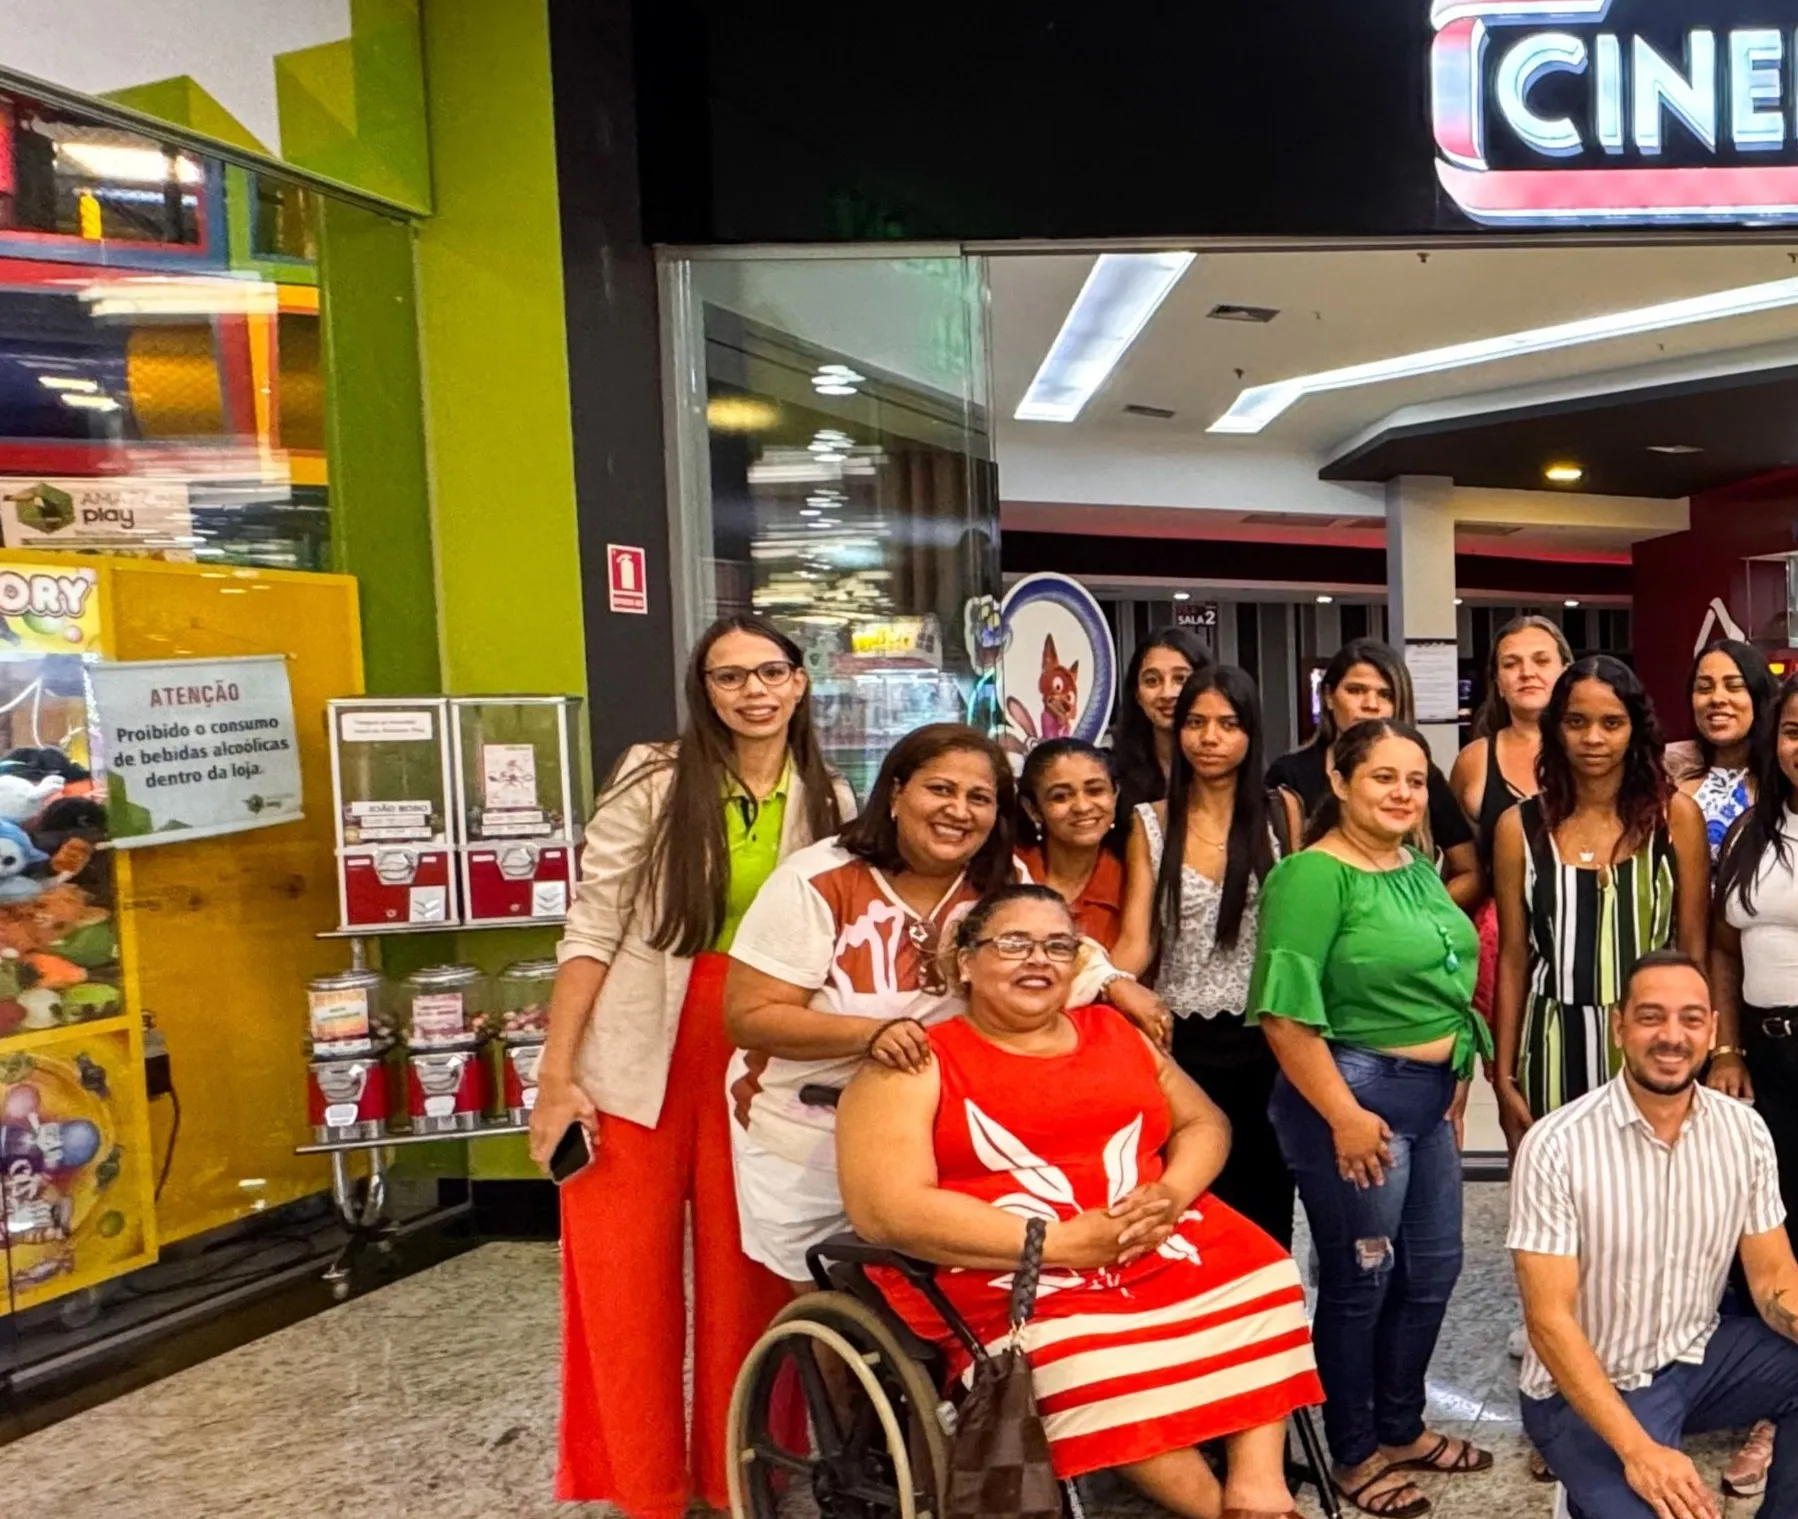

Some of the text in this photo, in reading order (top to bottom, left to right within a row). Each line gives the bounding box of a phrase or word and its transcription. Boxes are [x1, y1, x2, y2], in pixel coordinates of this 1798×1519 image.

[82, 507, 135, 529] play
[0, 570, 93, 619] ORY
[1178, 610, 1216, 626] SALA 2
[150, 680, 240, 708] ATENÇÃO
[116, 717, 279, 743] Proibido o consumo
[114, 737, 290, 768] de bebidas alcoólicas
[145, 762, 264, 788] dentro da loja.
